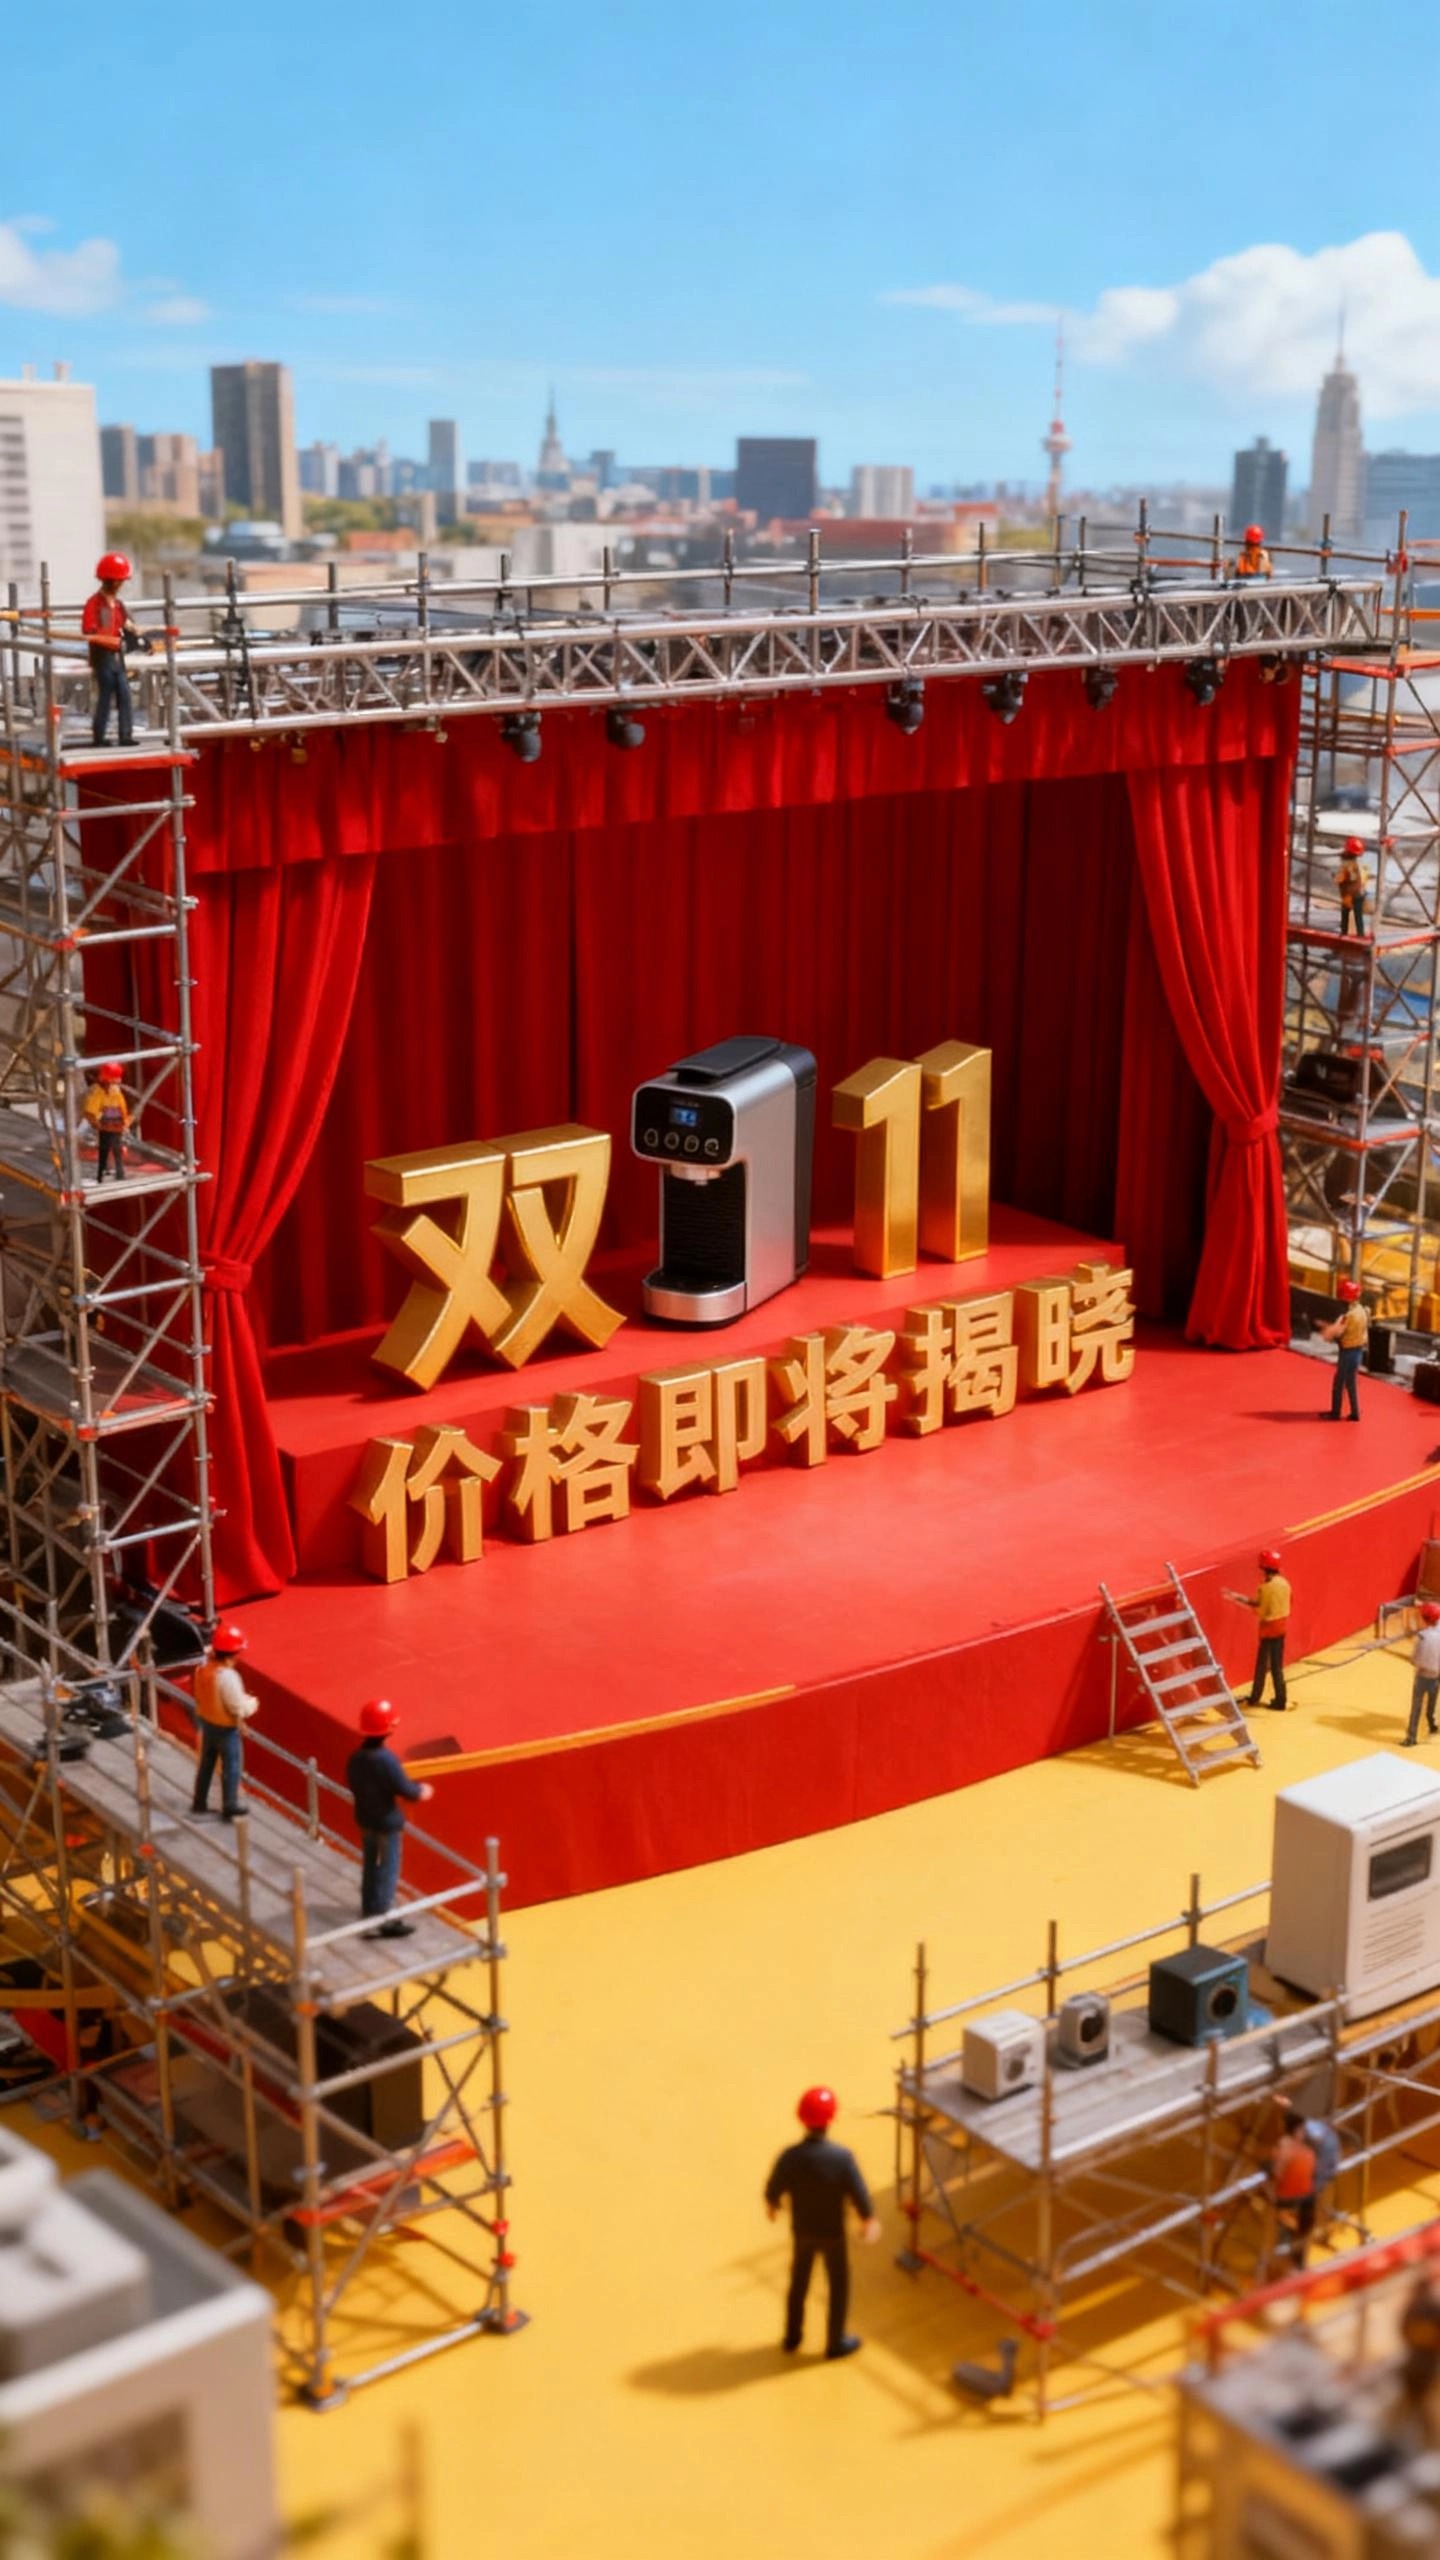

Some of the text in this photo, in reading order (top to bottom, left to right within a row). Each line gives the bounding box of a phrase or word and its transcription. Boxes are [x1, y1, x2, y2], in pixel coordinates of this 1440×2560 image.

[364, 1040, 992, 1391] 双 11
[350, 1261, 1136, 1584] 价格即将揭晓
